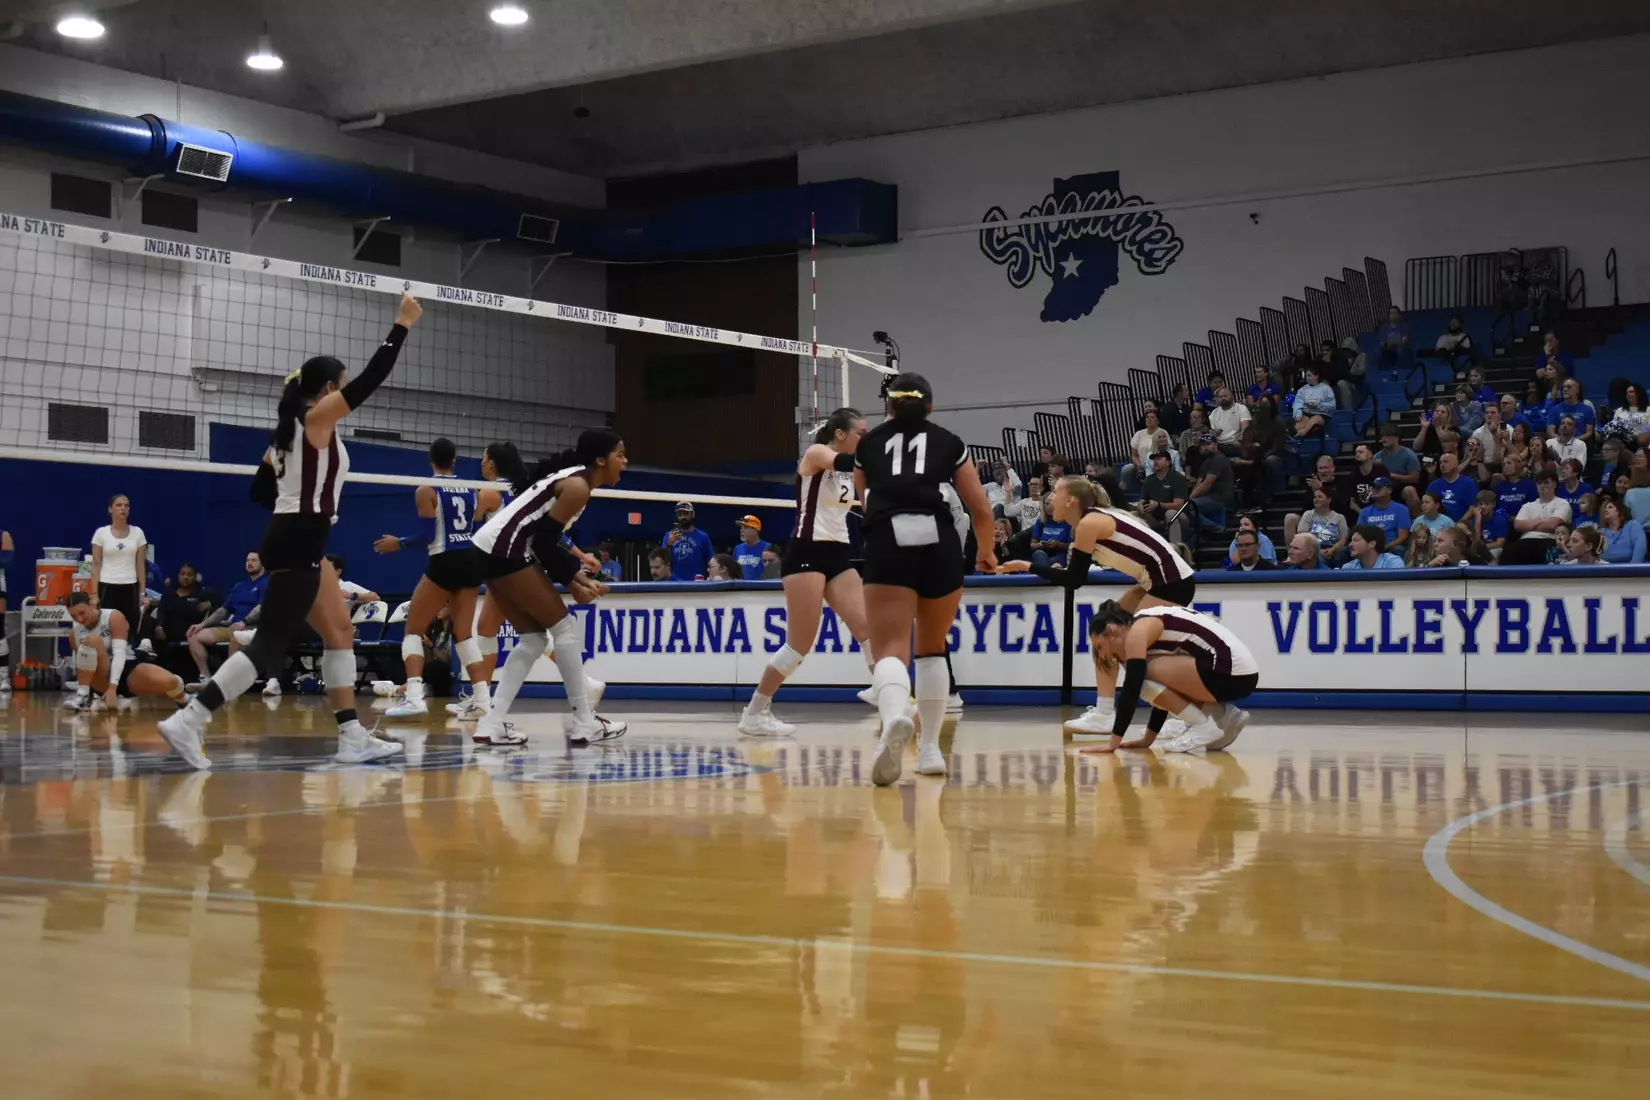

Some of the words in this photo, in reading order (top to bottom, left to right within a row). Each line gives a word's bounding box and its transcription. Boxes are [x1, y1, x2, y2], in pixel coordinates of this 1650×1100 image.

[24, 218, 66, 238] STATE
[144, 238, 191, 258] INDIANA
[195, 246, 232, 264] STATE
[300, 263, 341, 282] INDIANA
[344, 271, 377, 288] STATE
[437, 285, 473, 303] INDIANA
[476, 292, 505, 307] STATE
[557, 304, 590, 321] INDIANA
[592, 310, 618, 325] STATE
[664, 321, 694, 337] INDIANA
[696, 326, 719, 340] STATE
[760, 337, 787, 350] INDIANA
[788, 341, 809, 353] STATE
[884, 432, 928, 477] 11
[839, 484, 849, 503] 2
[451, 496, 468, 530] 3
[39, 574, 47, 588] G
[32, 608, 65, 620] Gatorade
[1266, 599, 1650, 655] VOLLEYBALL
